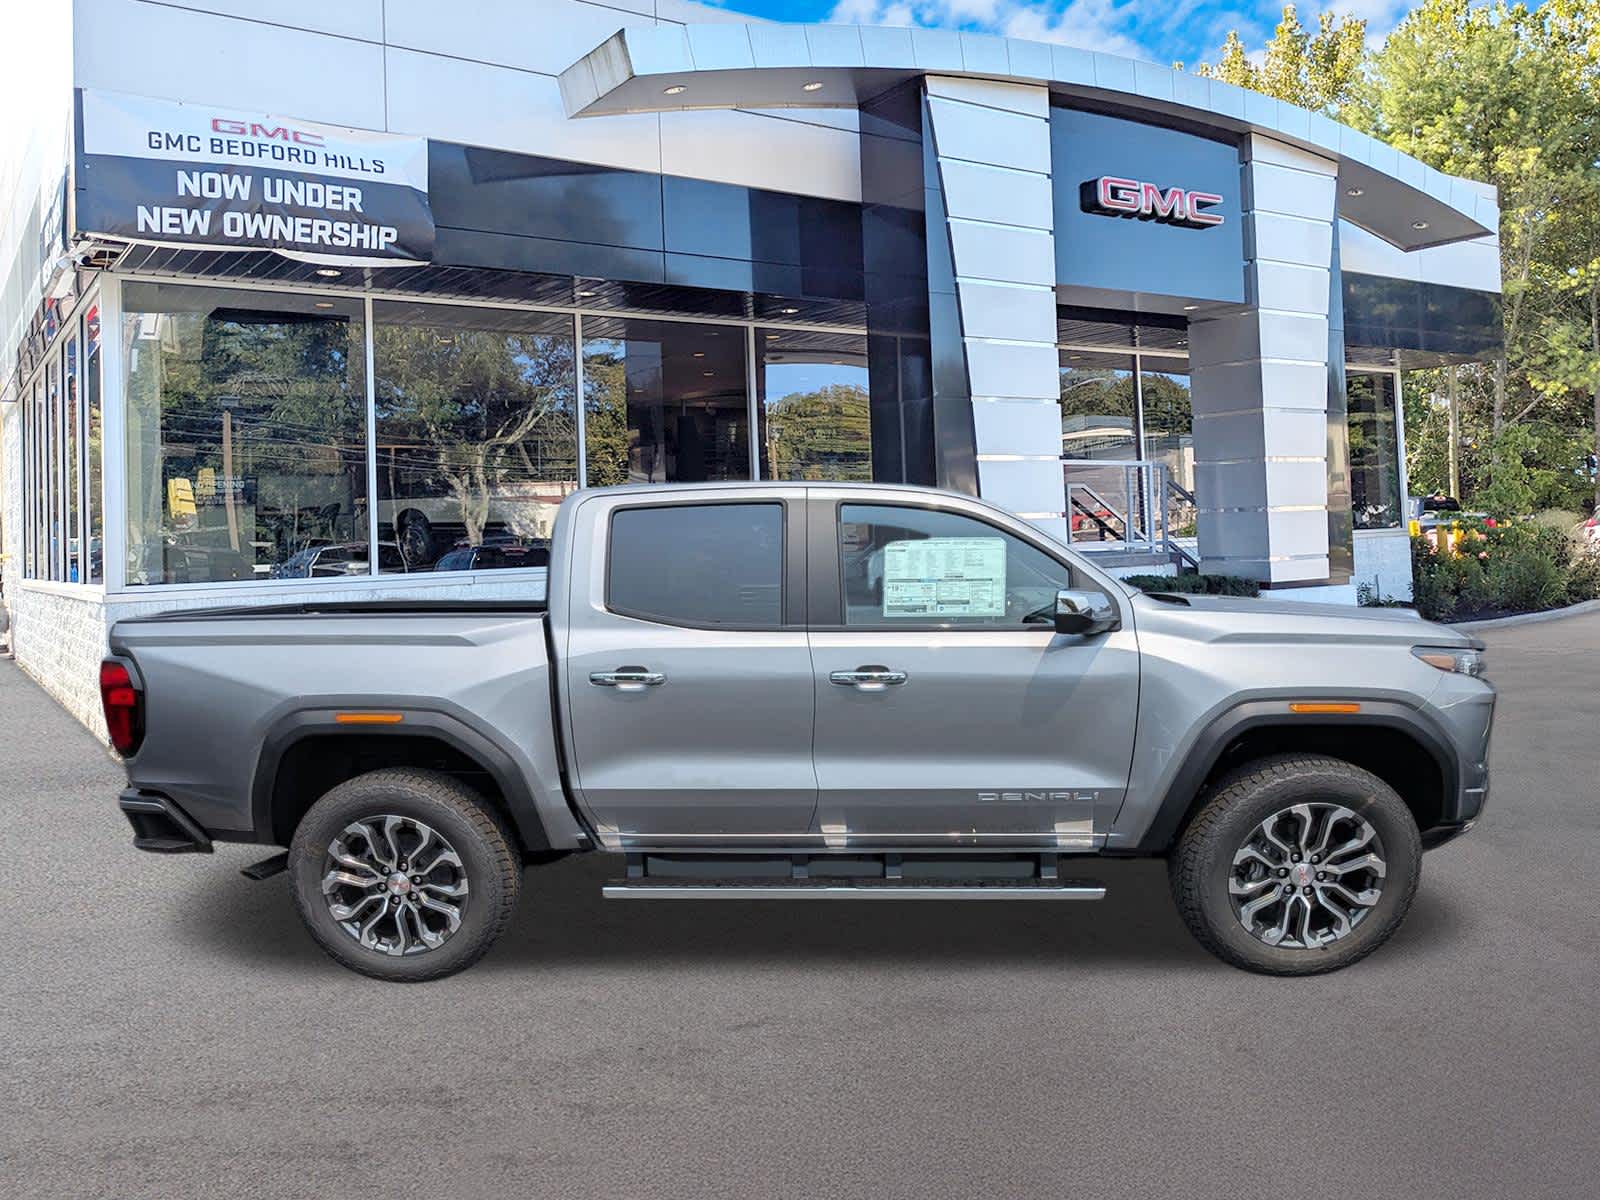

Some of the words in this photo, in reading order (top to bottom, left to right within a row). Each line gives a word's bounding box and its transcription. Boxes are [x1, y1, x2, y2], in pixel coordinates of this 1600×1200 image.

[148, 131, 200, 152] GMC
[210, 138, 316, 165] BEDFORD
[324, 152, 384, 173] HILLS
[211, 118, 326, 147] GMC
[177, 170, 252, 201] NOW
[263, 177, 363, 212] UNDER
[1097, 175, 1225, 225] GMC
[137, 205, 211, 236] NEW
[223, 211, 398, 250] OWNERSHIP
[977, 791, 1100, 801] DENALI
